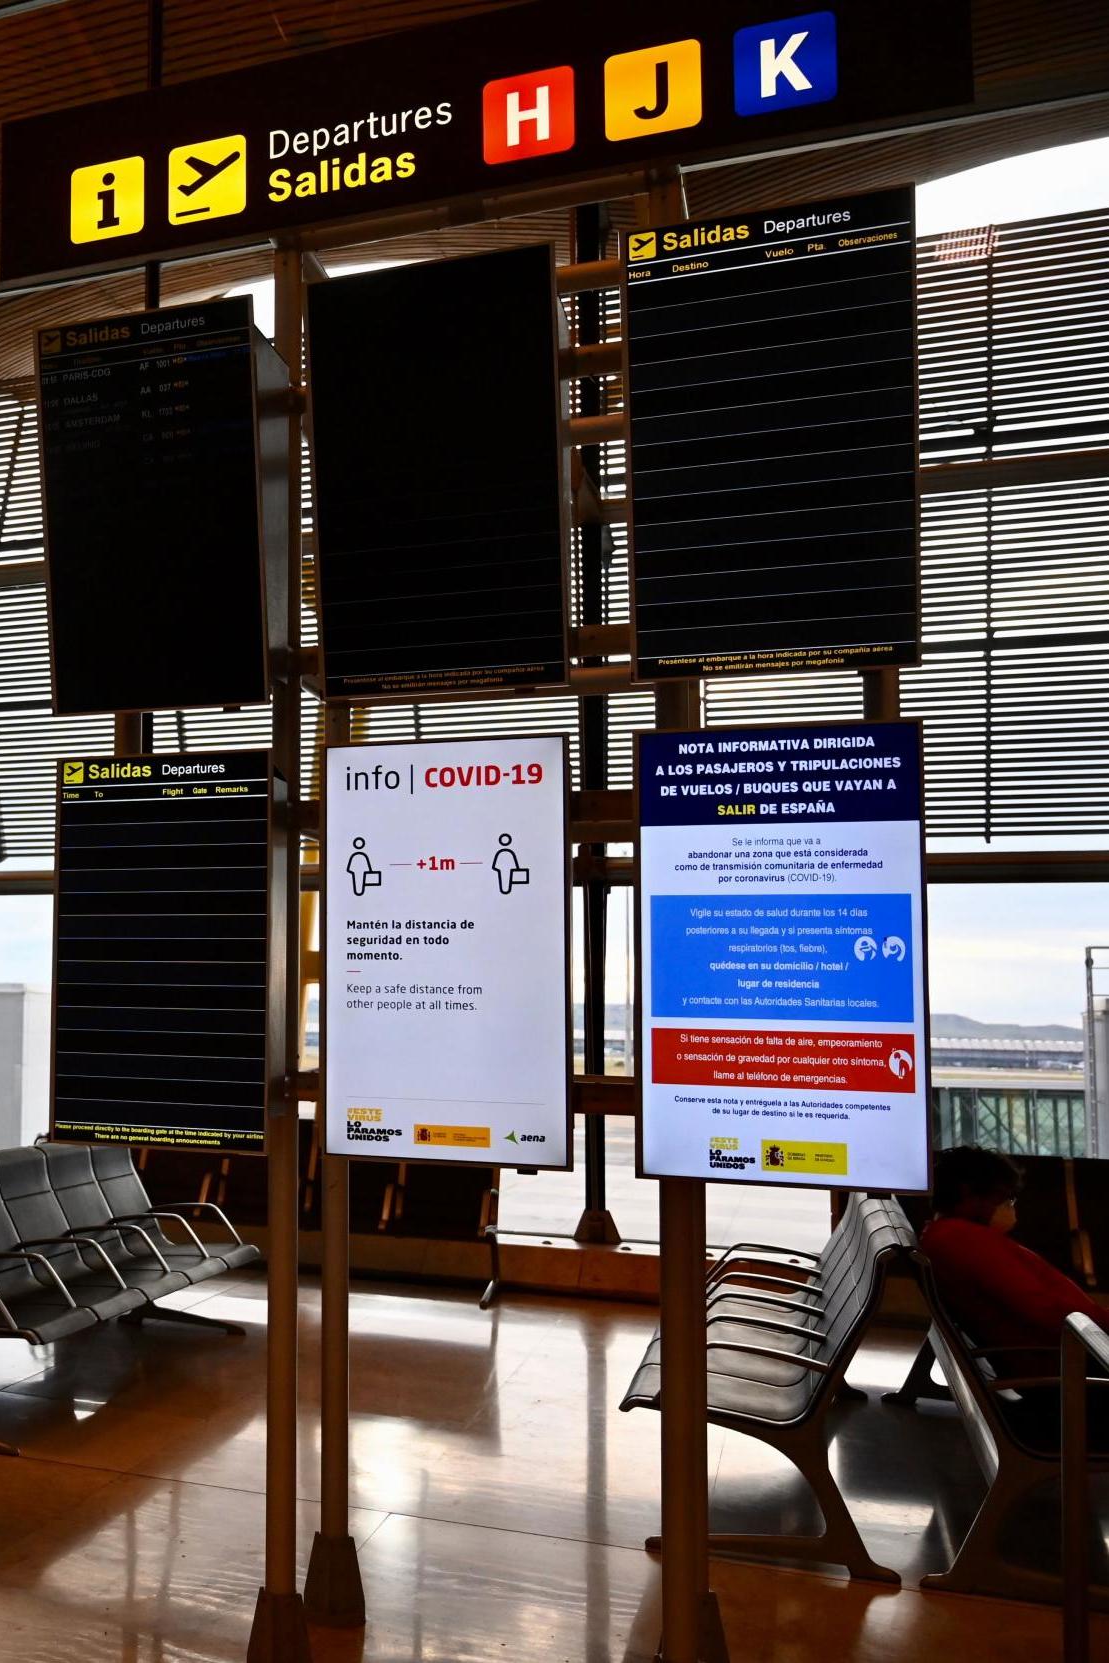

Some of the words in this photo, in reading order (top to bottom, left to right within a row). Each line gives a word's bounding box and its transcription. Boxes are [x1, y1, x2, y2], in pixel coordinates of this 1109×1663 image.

[760, 32, 813, 98] K
[633, 60, 671, 121] J
[507, 86, 550, 147] H
[270, 101, 452, 159] Departures
[269, 152, 416, 203] Salidas
[662, 224, 750, 250] Salidas
[763, 211, 851, 233] Departures
[764, 247, 794, 258] Vuelo
[837, 232, 899, 248] Observaciones
[628, 270, 651, 279] Hora
[672, 261, 709, 272] Destino
[66, 324, 131, 346] Salidas
[141, 316, 206, 335] Departures
[678, 742, 714, 754] NOTA
[718, 738, 810, 752] INFORMATIVA
[813, 736, 875, 749] DIRIGIDA
[88, 763, 152, 779] Salidas
[161, 763, 225, 776] Departures
[655, 765, 665, 776] A
[667, 764, 693, 775] LOS
[696, 761, 774, 774] PASAJEROS
[777, 760, 787, 772] Y
[789, 756, 901, 771] TRIPULACIONES
[346, 765, 400, 791] info
[424, 763, 543, 788] COVID-19
[162, 788, 183, 797] Flight
[192, 786, 207, 794] Gate
[215, 785, 249, 793] Remarks
[660, 785, 677, 796] DE
[680, 783, 733, 795] VUELOS
[743, 781, 799, 794] BUQUES
[801, 780, 831, 792] QUE
[834, 779, 882, 791] VAYAN
[886, 778, 897, 790] A
[62, 791, 80, 799] Time
[94, 790, 104, 798] To
[717, 804, 755, 815] SALIR
[759, 803, 778, 815] DE
[780, 799, 835, 814] ESPAÑA
[731, 837, 743, 846] Se
[744, 838, 752, 846] le
[754, 837, 784, 846] informa
[786, 838, 802, 847] que
[803, 837, 814, 845] va
[815, 837, 821, 845] a
[687, 850, 732, 859] abandonar
[752, 850, 773, 858] zona
[774, 850, 792, 859] que
[793, 848, 812, 857] está
[813, 847, 868, 857] considerada
[416, 856, 455, 871] +1m
[699, 862, 710, 871] de
[712, 862, 762, 870] transmisión
[764, 861, 815, 870] comunitaria
[817, 861, 829, 869] de
[830, 860, 883, 869] enfermedad
[718, 875, 732, 884] por
[734, 873, 785, 882] coronavirus
[690, 907, 712, 919] Vigile
[713, 909, 724, 917] su
[724, 908, 752, 917] estado
[753, 908, 765, 917] de
[766, 907, 789, 917] salud
[789, 908, 821, 917] durante
[822, 908, 835, 917] los
[838, 907, 847, 916] 14
[346, 919, 388, 929] Mantén
[391, 919, 401, 929] la
[404, 919, 456, 929] distancia
[459, 919, 474, 929] de
[346, 934, 402, 947] seguridad
[405, 936, 419, 945] en
[423, 934, 449, 945] todo
[747, 962, 759, 970] en
[760, 962, 772, 970] su
[773, 961, 814, 970] domicilio
[820, 961, 843, 971] hotel
[346, 983, 372, 995] Keep
[375, 985, 381, 994] a
[384, 983, 406, 994] safe
[409, 983, 454, 994] distance
[457, 984, 482, 995] from
[737, 978, 760, 989] lugar
[761, 979, 773, 988] de
[774, 979, 820, 988] residencia
[346, 998, 373, 1009] other
[377, 999, 412, 1011] people
[415, 1000, 426, 1010] at
[428, 999, 441, 1010] all
[680, 1033, 689, 1043] Si
[690, 1034, 710, 1043] tiene
[753, 1035, 764, 1045] de
[765, 1035, 783, 1045] falta
[784, 1036, 796, 1046] de
[817, 1039, 883, 1048] empeoramiento
[725, 1053, 736, 1062] de
[737, 1054, 775, 1064] gravedad
[776, 1055, 791, 1065] por
[792, 1055, 830, 1066] cualquier
[831, 1056, 849, 1065] otro
[713, 1070, 735, 1079] llame
[736, 1071, 745, 1080] al
[779, 1072, 791, 1082] de
[674, 1095, 706, 1103] Conserve
[722, 1097, 738, 1105] nota
[788, 1099, 800, 1107] las
[800, 1100, 843, 1109] Autoridades
[844, 1103, 891, 1111] competentes
[347, 1127, 403, 1136] PARAMOS
[347, 1134, 390, 1142] UNIDOS
[520, 1134, 546, 1143] aena
[709, 1155, 756, 1164] PARAMOS
[709, 1162, 746, 1170] UNIDOS
